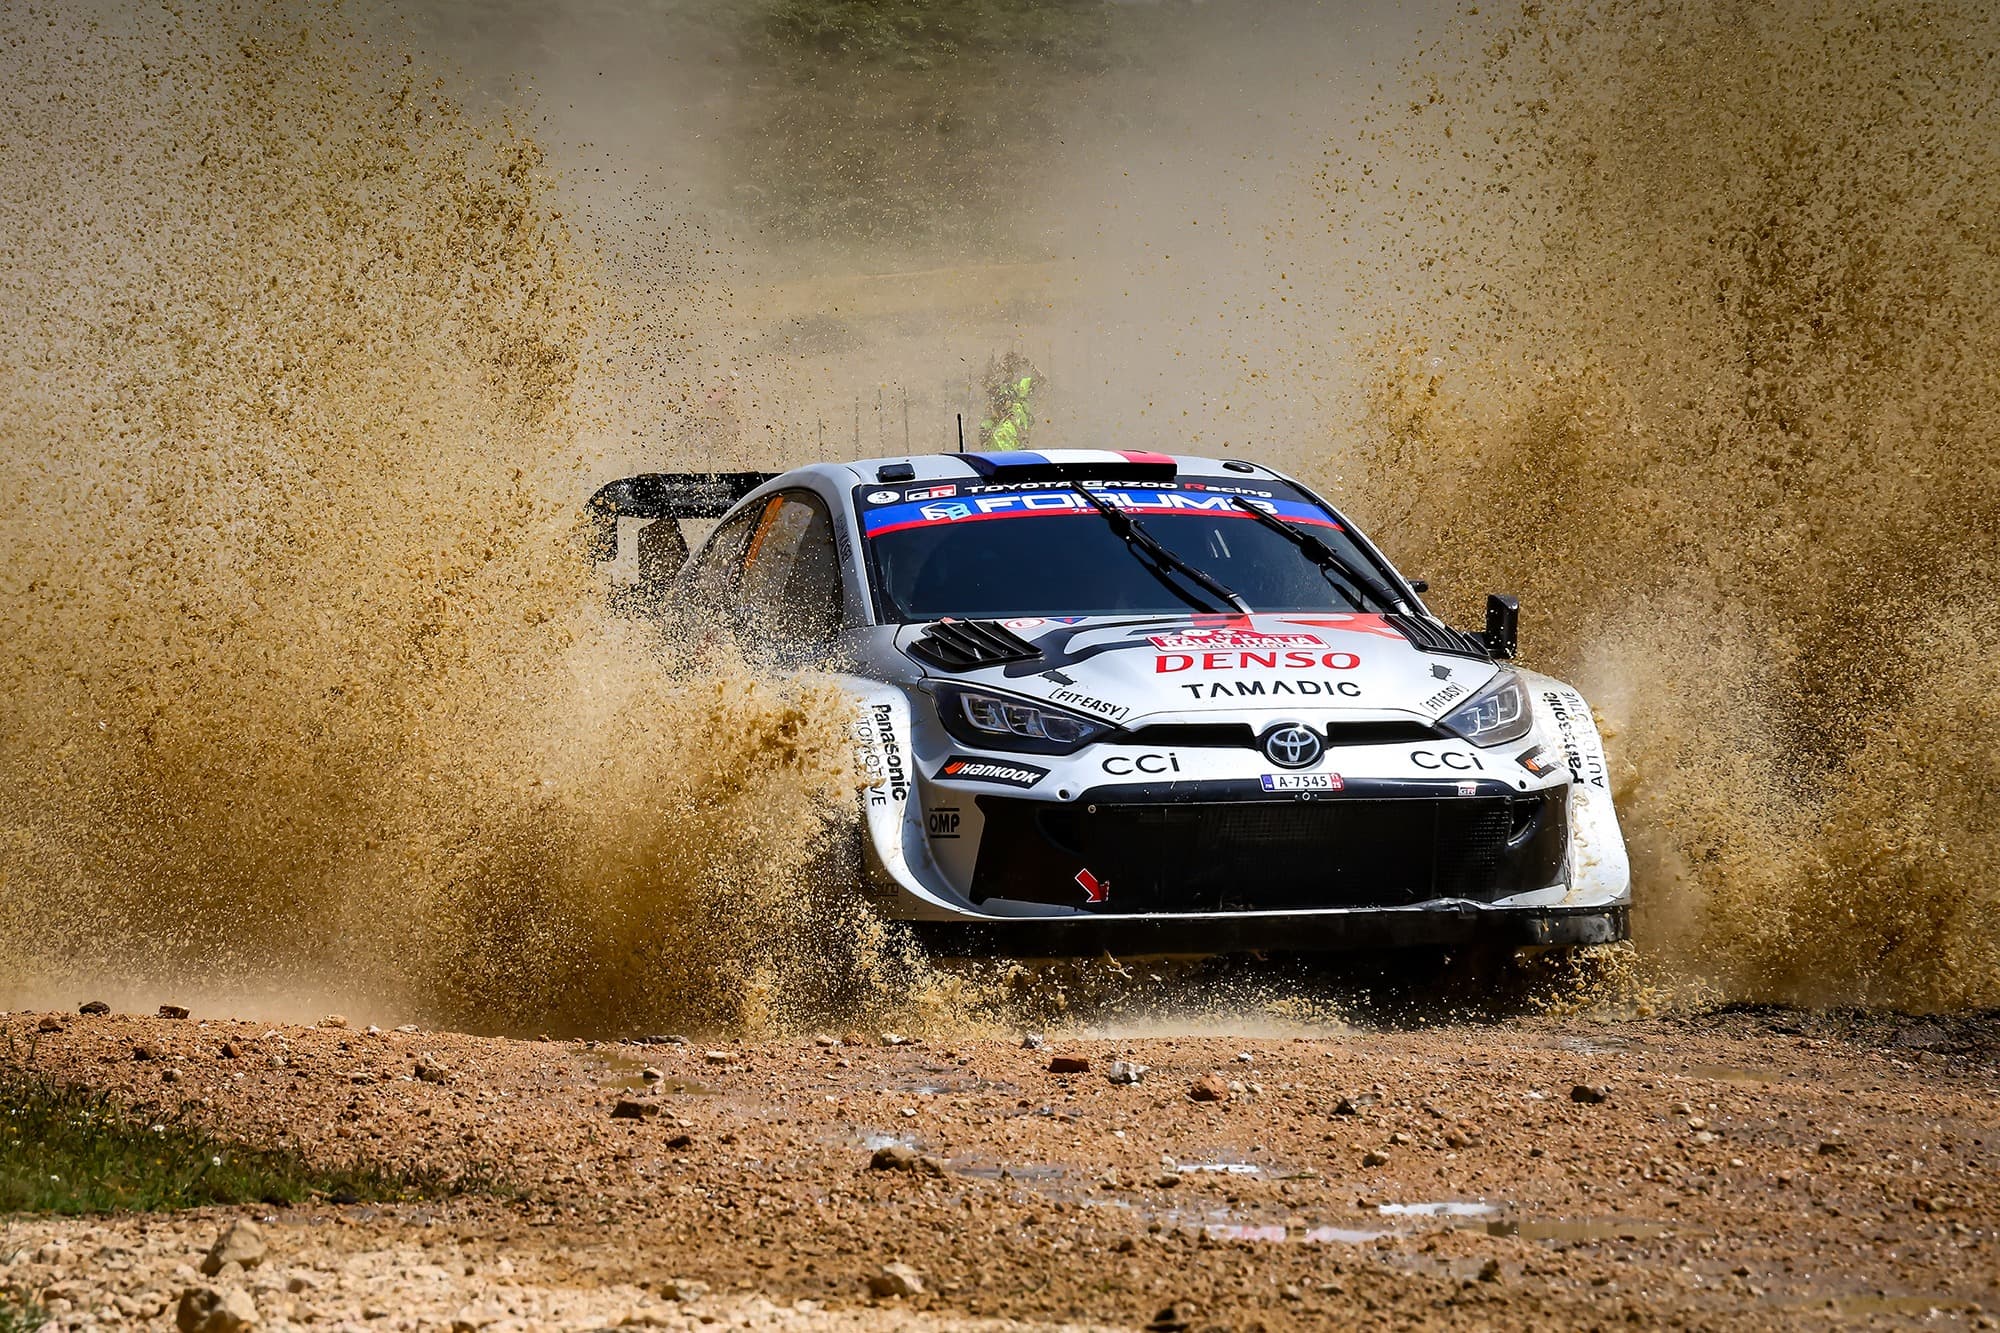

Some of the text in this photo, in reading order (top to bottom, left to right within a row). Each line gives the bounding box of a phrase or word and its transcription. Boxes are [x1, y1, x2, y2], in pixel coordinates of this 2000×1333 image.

[965, 480, 1272, 498] TOYOTA GAZOO Racing
[1155, 651, 1361, 674] DENSO
[1181, 680, 1362, 699] TAMADIC
[871, 704, 912, 801] Panasonic
[1279, 776, 1328, 788] A-7545
[929, 812, 960, 833] OMP
